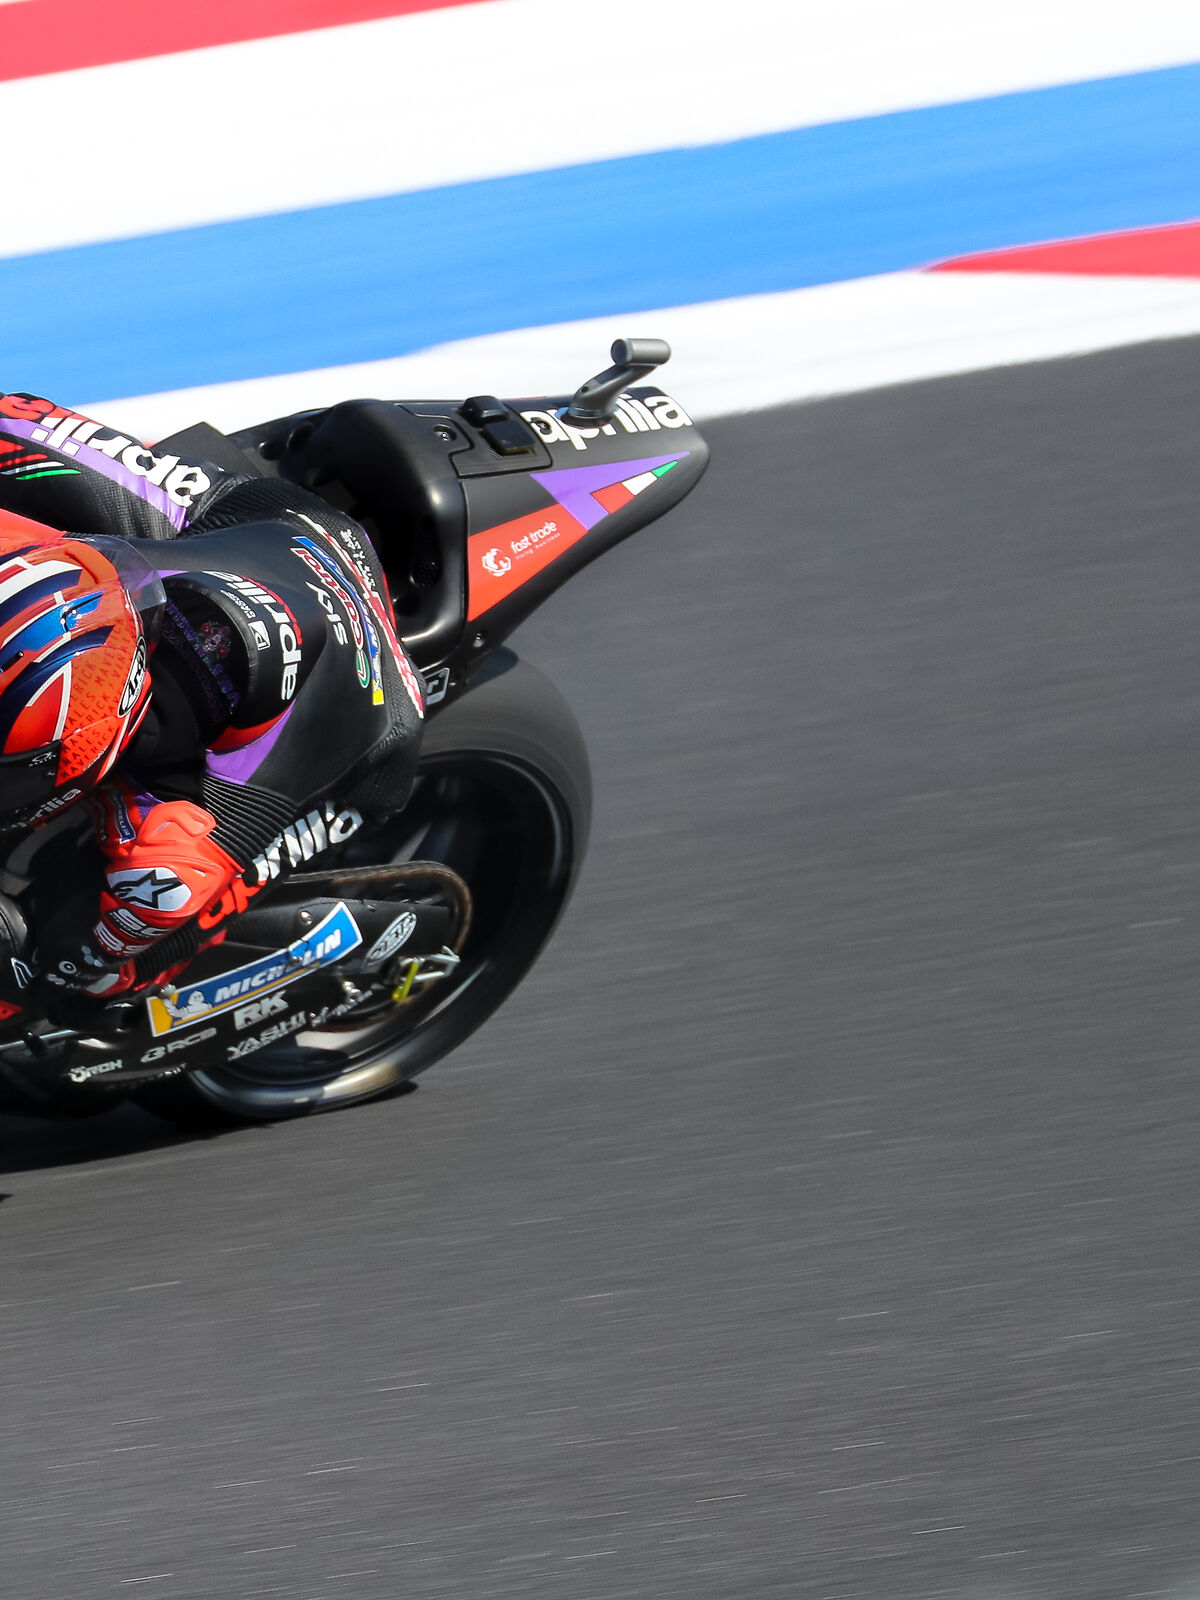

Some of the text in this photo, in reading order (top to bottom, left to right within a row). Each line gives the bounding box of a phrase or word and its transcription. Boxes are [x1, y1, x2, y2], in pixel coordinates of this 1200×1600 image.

[511, 536, 532, 553] fast
[529, 521, 557, 543] trade
[304, 580, 349, 646] sky
[213, 928, 342, 1004] MICHLIN
[233, 990, 289, 1030] RK
[227, 1011, 306, 1061] YASHI
